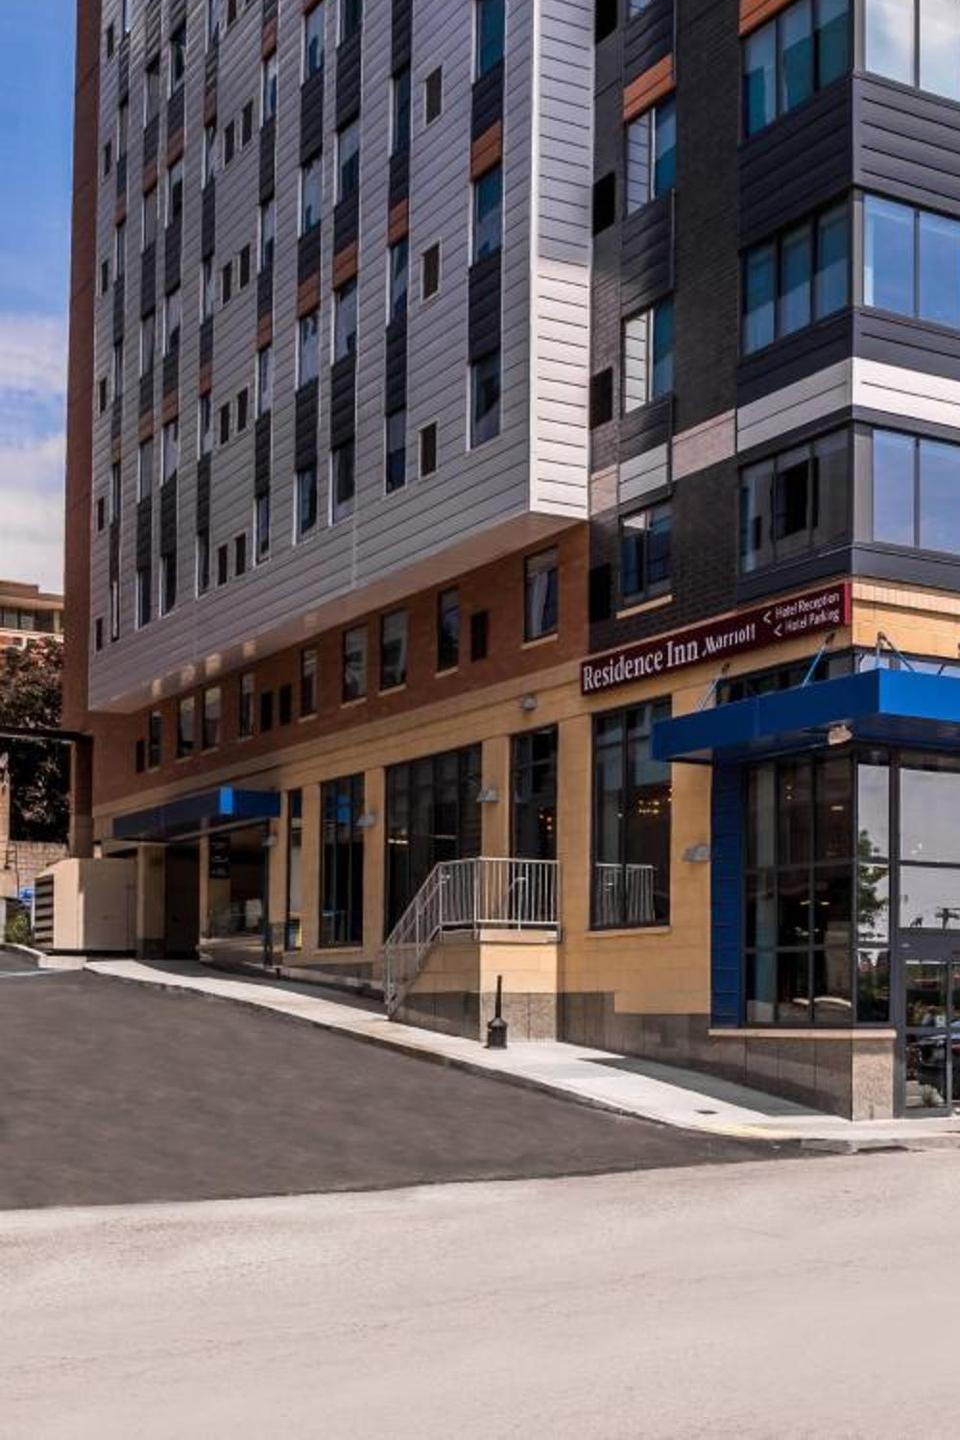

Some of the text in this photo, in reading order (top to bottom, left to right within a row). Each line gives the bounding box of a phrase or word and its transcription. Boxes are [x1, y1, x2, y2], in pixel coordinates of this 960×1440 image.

[775, 602, 797, 619] Hotel
[583, 623, 756, 691] Residence Inn Marriott
